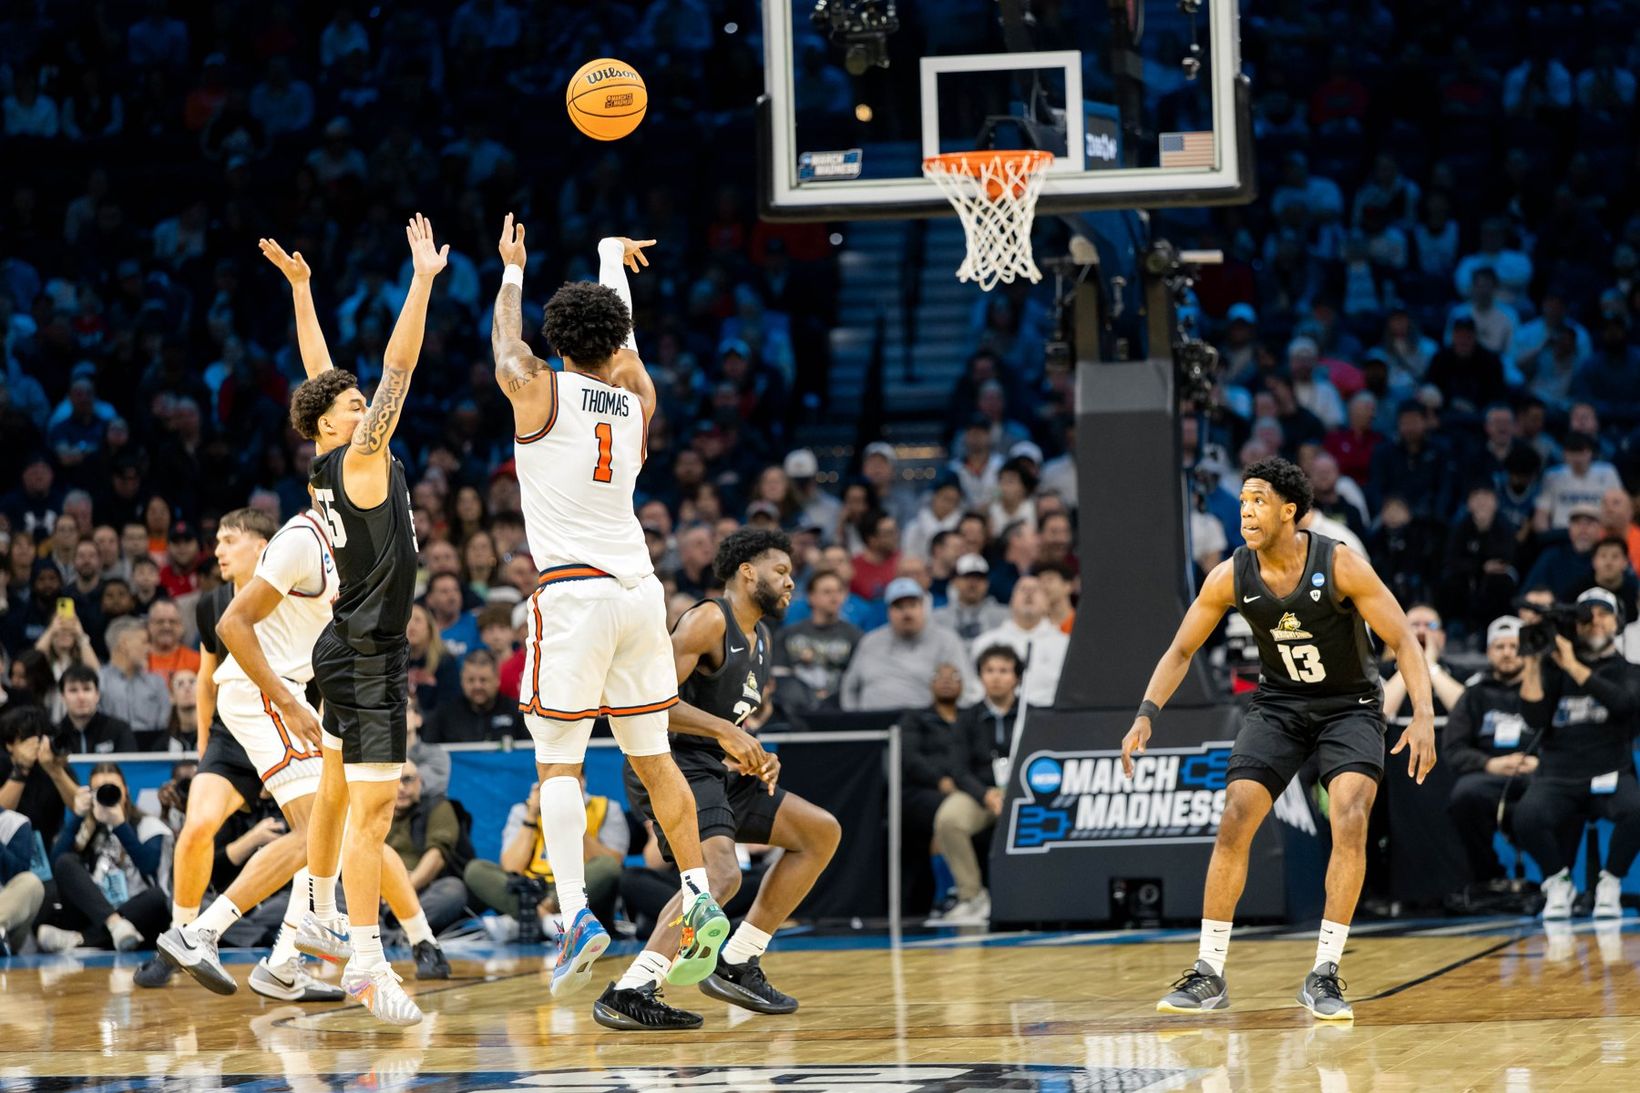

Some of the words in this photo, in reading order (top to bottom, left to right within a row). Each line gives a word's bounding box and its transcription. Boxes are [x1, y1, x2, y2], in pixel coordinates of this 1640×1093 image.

[586, 66, 638, 84] Wilson
[581, 388, 629, 417] THOMAS
[592, 422, 613, 483] 1
[1277, 644, 1326, 683] 13
[1060, 755, 1180, 796] MARCH
